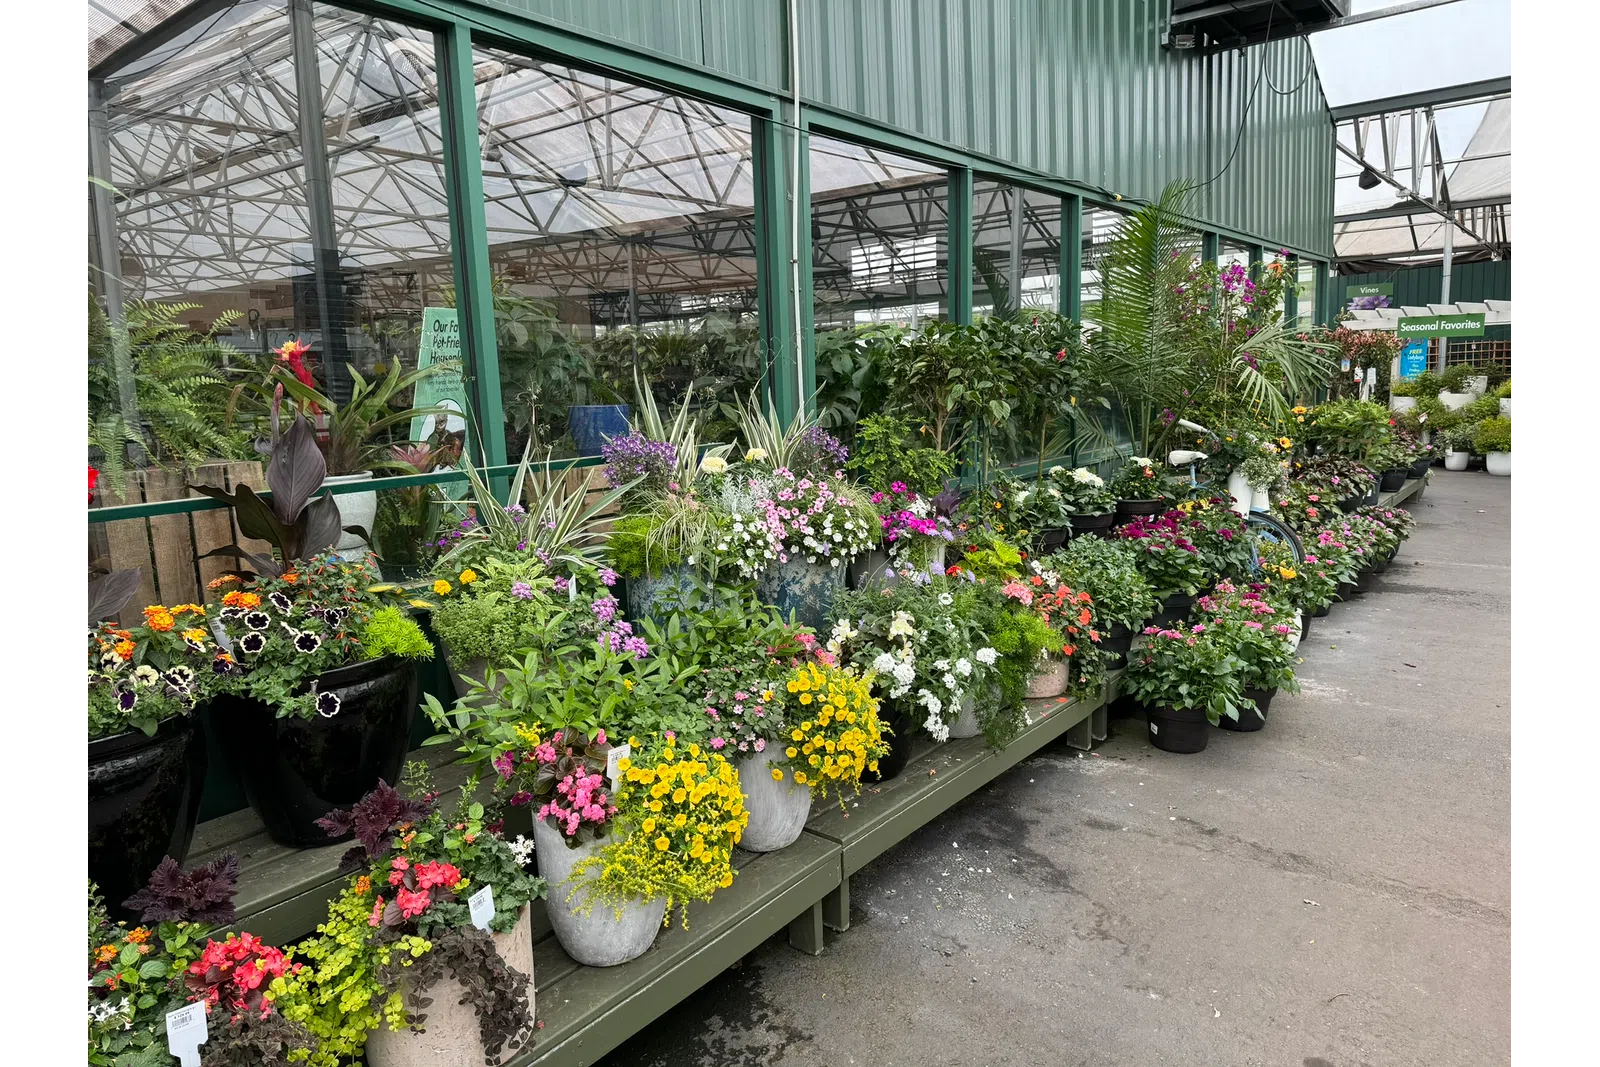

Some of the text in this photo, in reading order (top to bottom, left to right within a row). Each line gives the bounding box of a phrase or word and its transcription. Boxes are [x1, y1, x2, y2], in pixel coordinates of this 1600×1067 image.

[433, 320, 448, 333] Our
[1400, 319, 1481, 332] Seasonal Favorites
